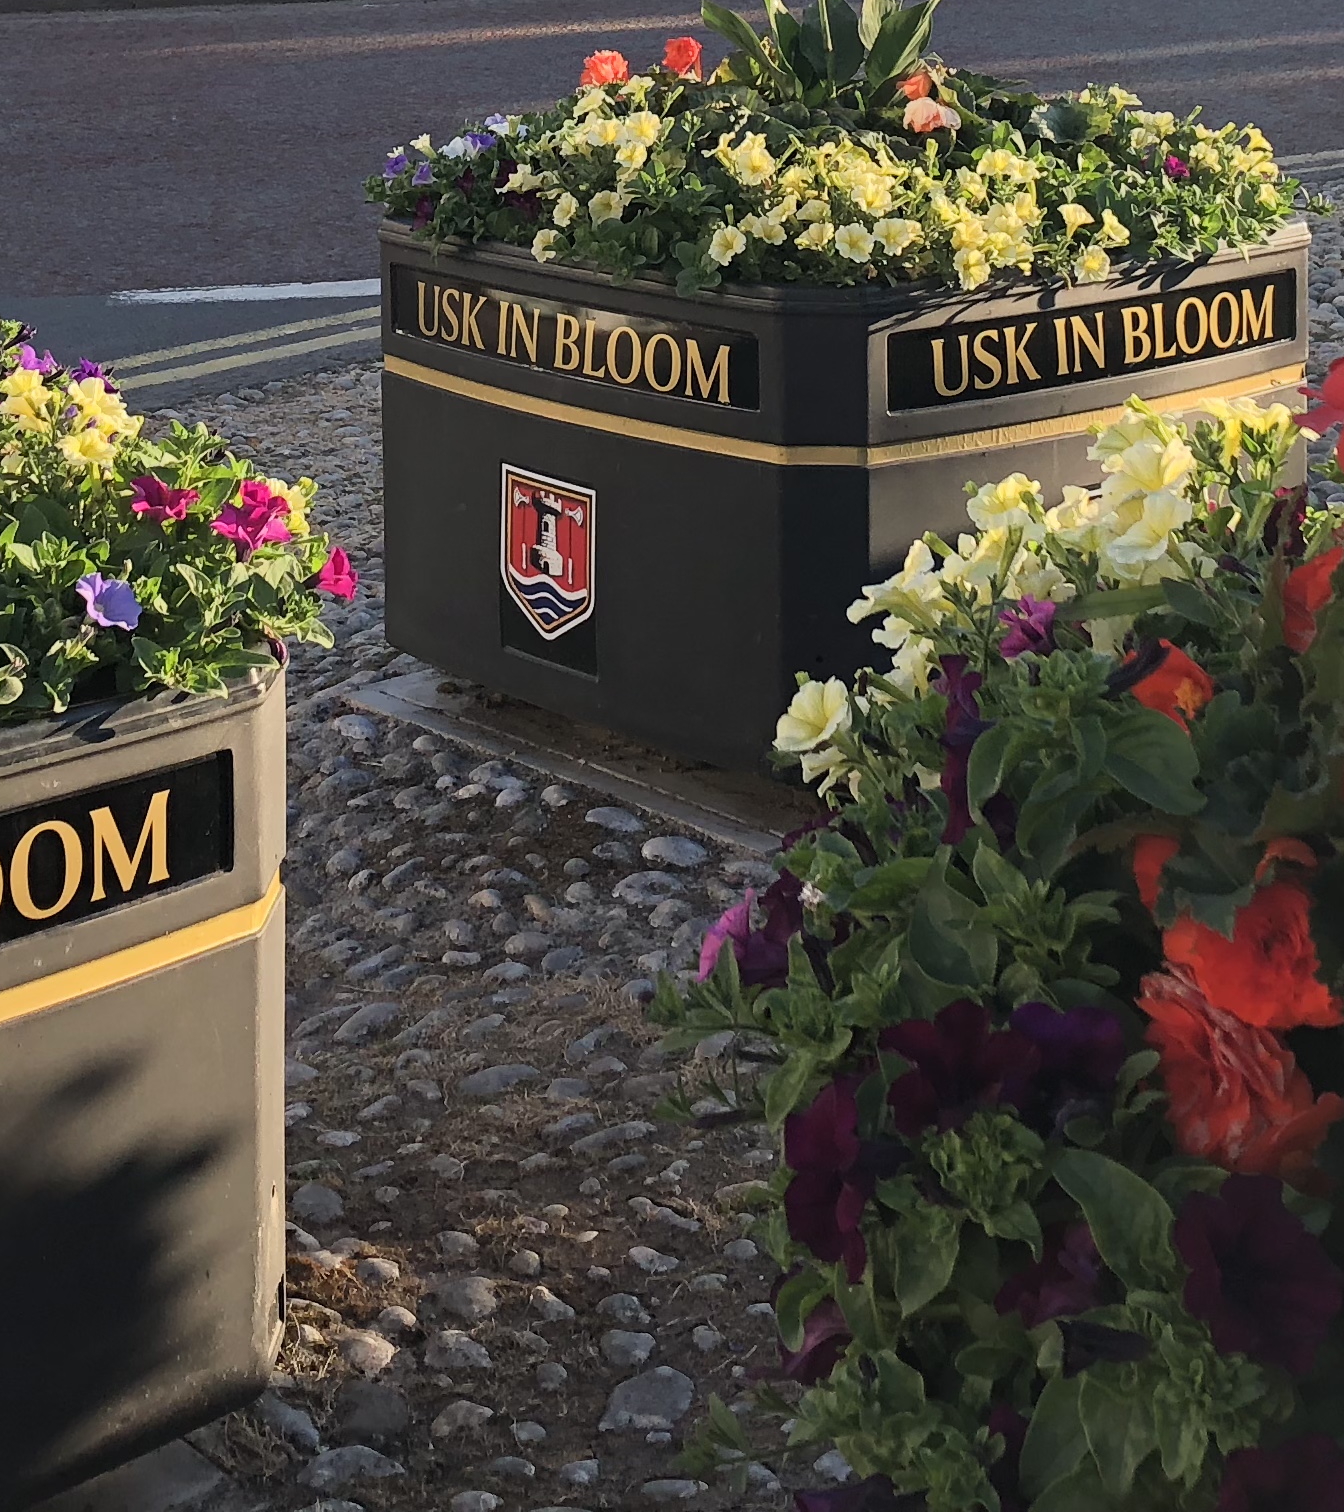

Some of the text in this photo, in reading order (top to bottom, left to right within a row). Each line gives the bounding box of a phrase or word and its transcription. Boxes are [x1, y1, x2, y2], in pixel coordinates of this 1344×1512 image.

[417, 281, 732, 406] USK IN BLOOM
[930, 284, 1276, 397] USK IN BLOOM
